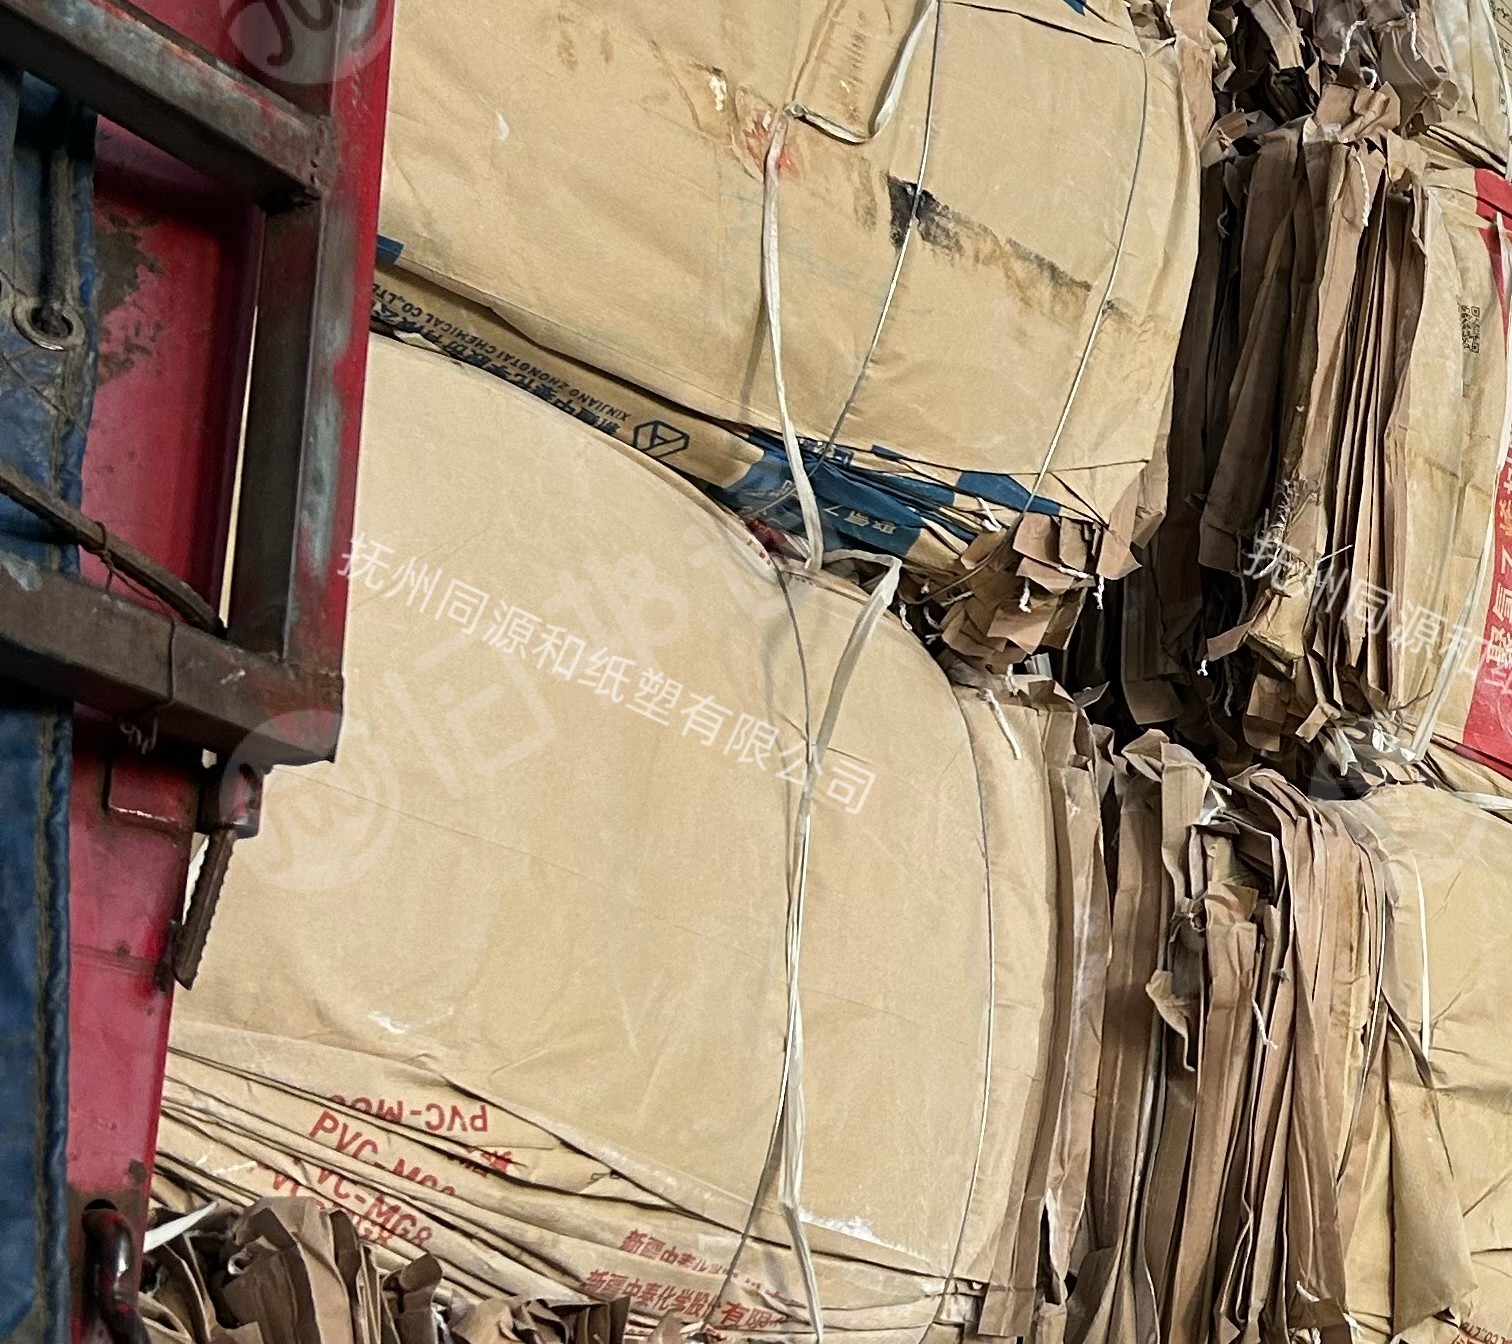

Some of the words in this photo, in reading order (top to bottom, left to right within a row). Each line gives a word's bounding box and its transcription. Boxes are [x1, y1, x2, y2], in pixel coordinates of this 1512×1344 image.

[424, 312, 496, 355] CHEMICAL
[496, 350, 570, 392] ZHONGTAI
[570, 387, 631, 423] XINJIANG
